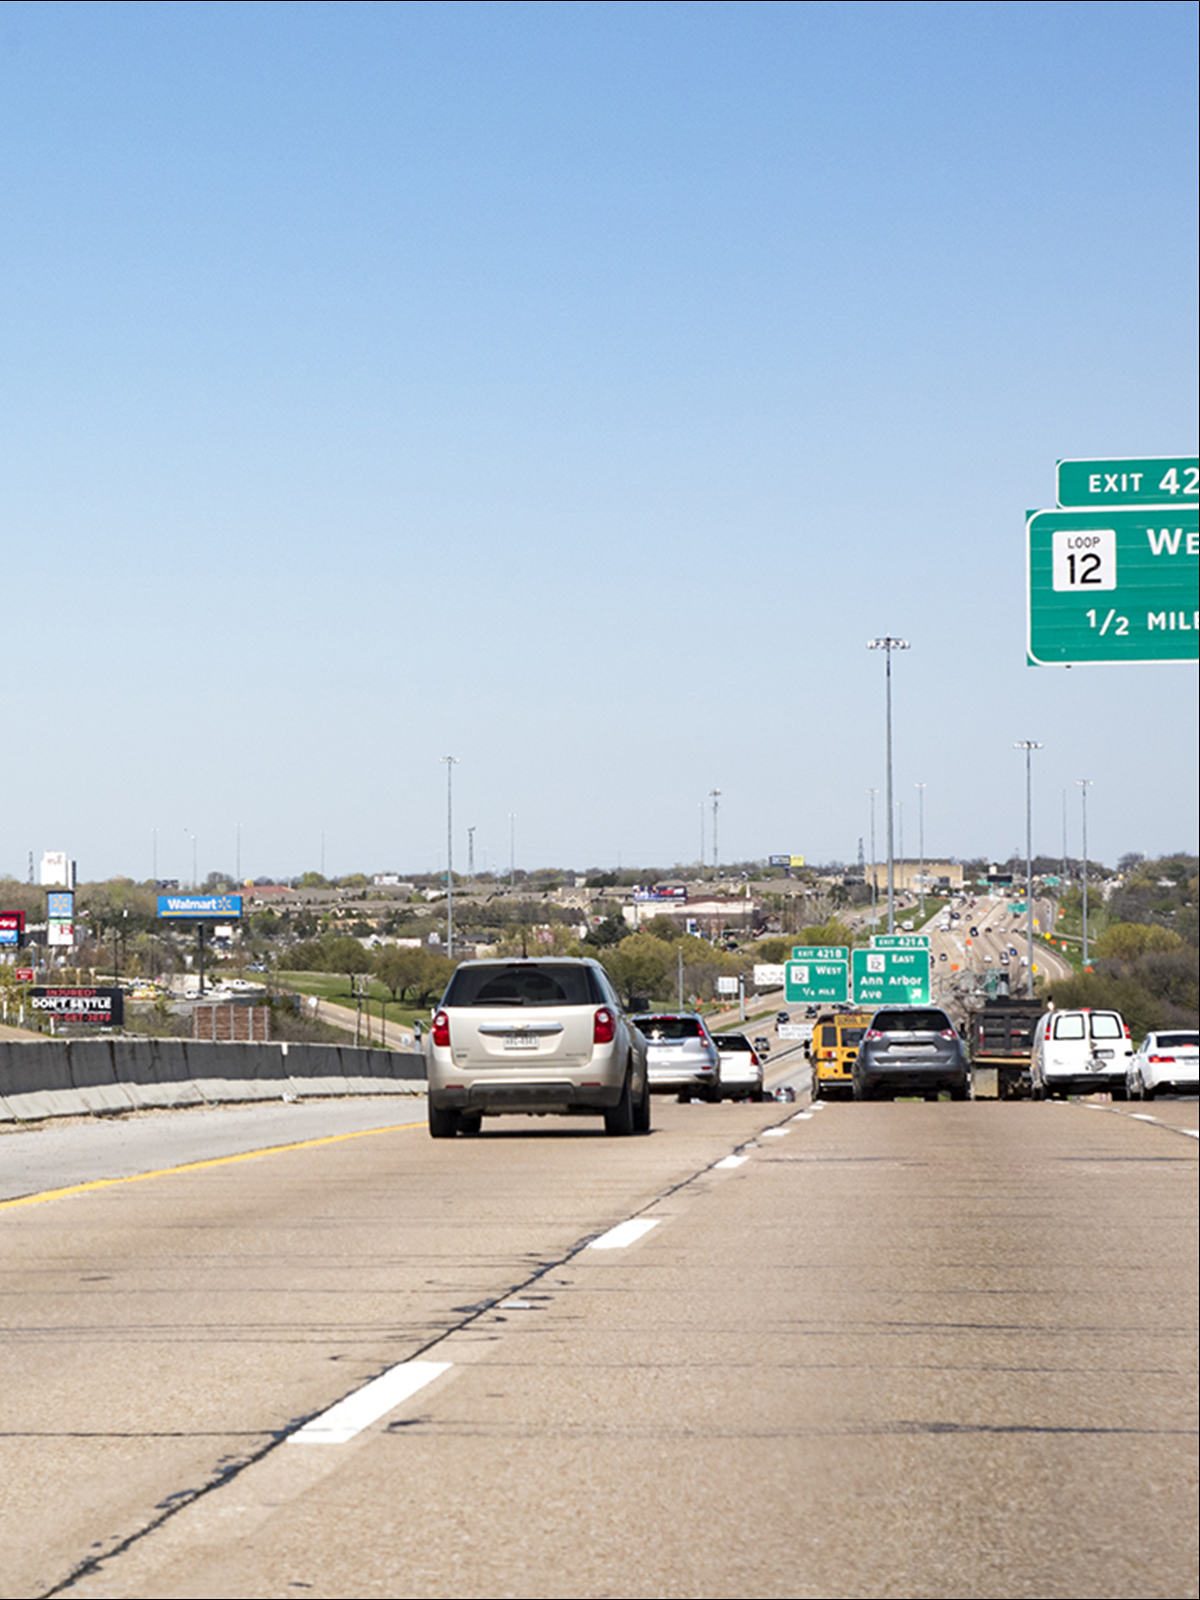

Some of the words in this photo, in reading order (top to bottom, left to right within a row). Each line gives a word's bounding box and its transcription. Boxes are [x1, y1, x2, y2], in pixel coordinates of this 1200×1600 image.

[1088, 473, 1144, 493] EXIT
[1158, 467, 1199, 495] 42
[1067, 536, 1101, 549] LOOP
[1066, 553, 1102, 585] 12
[167, 898, 217, 910] Walmart
[870, 960, 882, 971] 12
[891, 954, 915, 963] EAST
[794, 972, 805, 982] 12
[815, 965, 842, 975] WEST
[860, 976, 884, 986] Ann
[889, 975, 922, 986] Arbor
[46, 988, 97, 997] INJURED?
[860, 990, 882, 999] Ave
